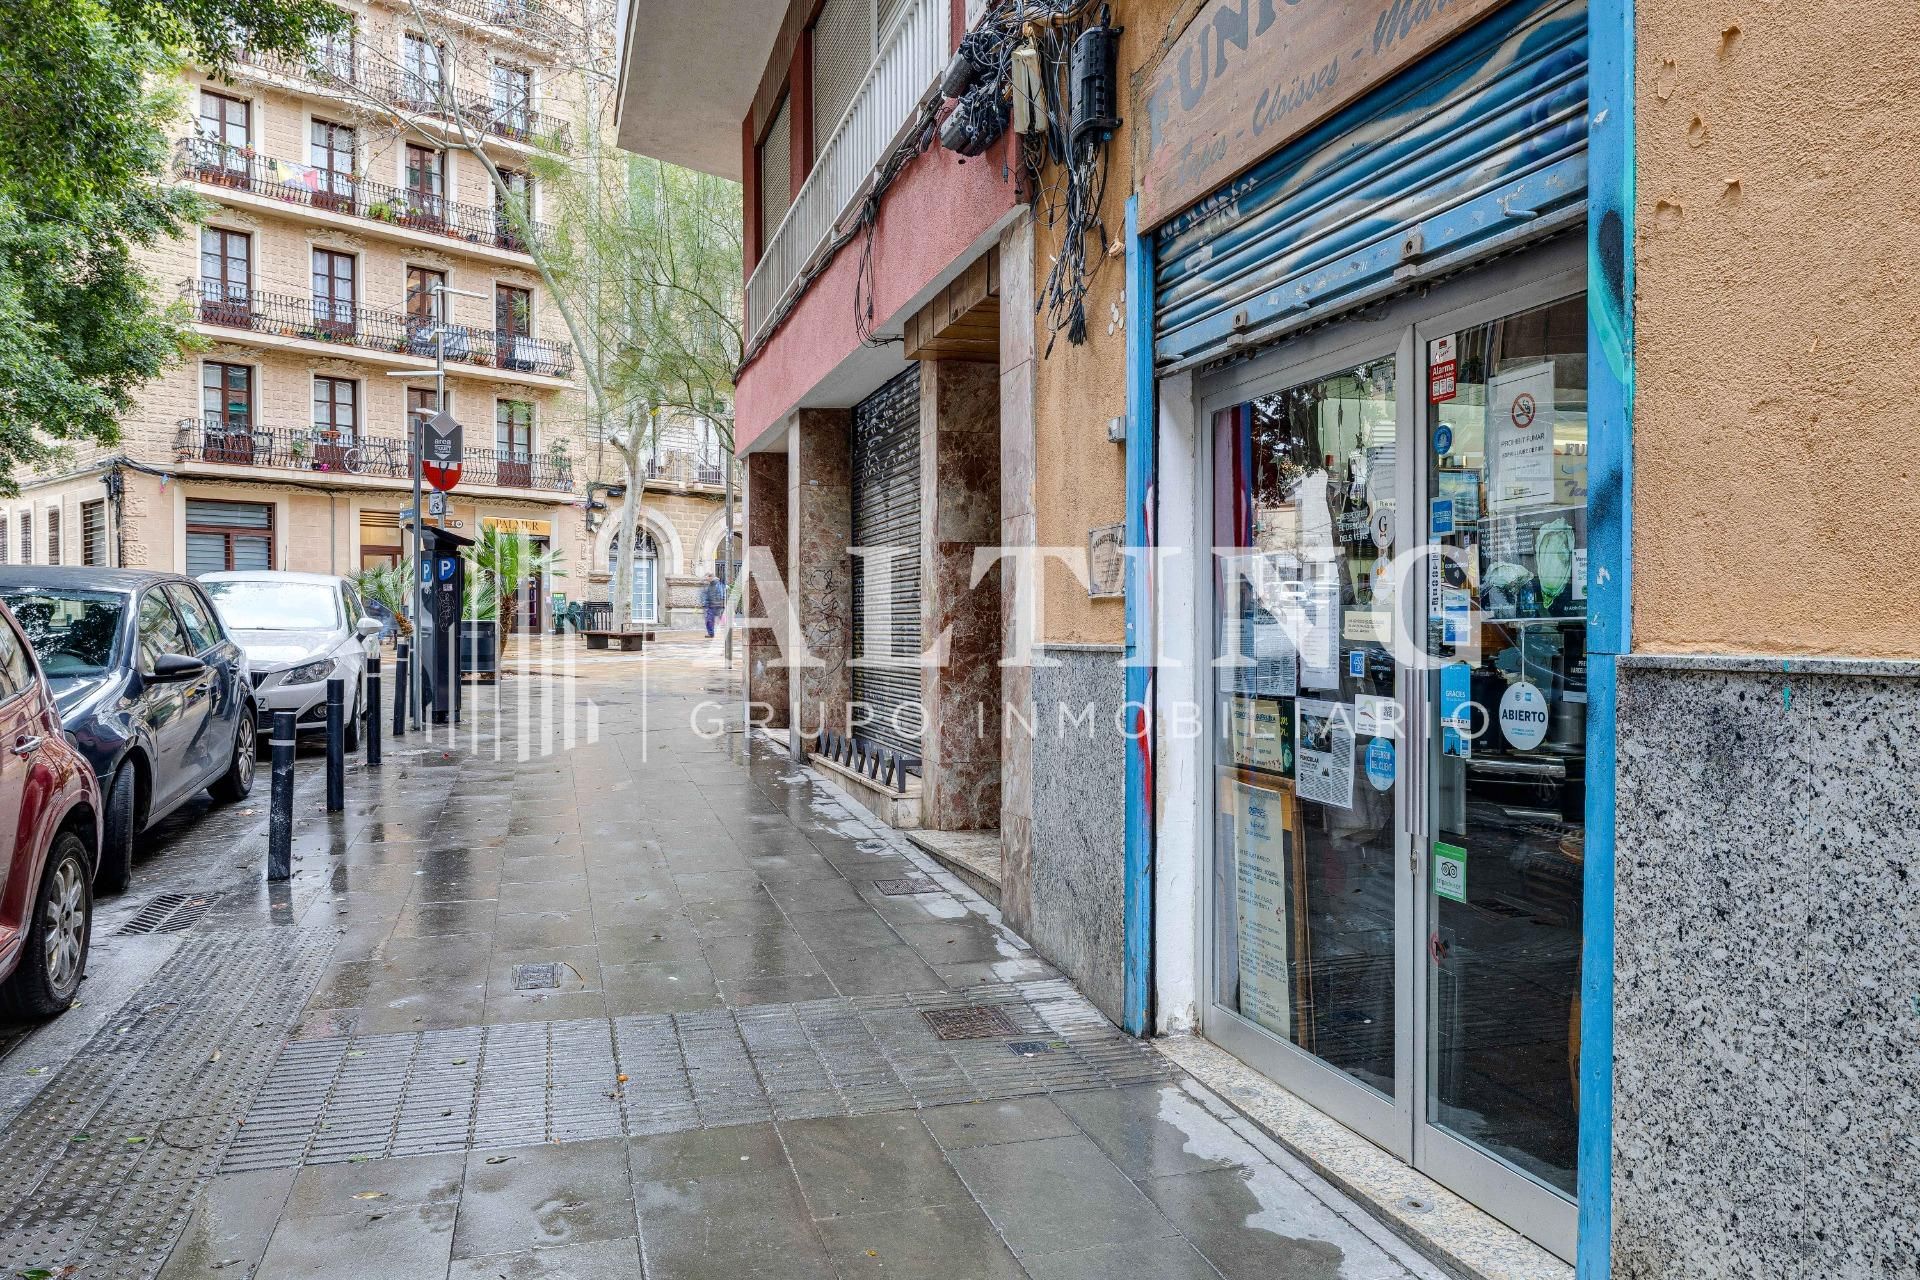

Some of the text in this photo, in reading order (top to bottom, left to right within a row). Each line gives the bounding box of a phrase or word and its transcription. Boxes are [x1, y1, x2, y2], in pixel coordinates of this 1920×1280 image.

[1147, 0, 1300, 152] FUN
[1252, 55, 1341, 137] Cloïsses
[1433, 363, 1454, 376] Alarma
[1566, 443, 1587, 456] FU
[496, 519, 539, 531] PALMER
[441, 560, 451, 576] P
[1501, 708, 1546, 723] ABIERTO
